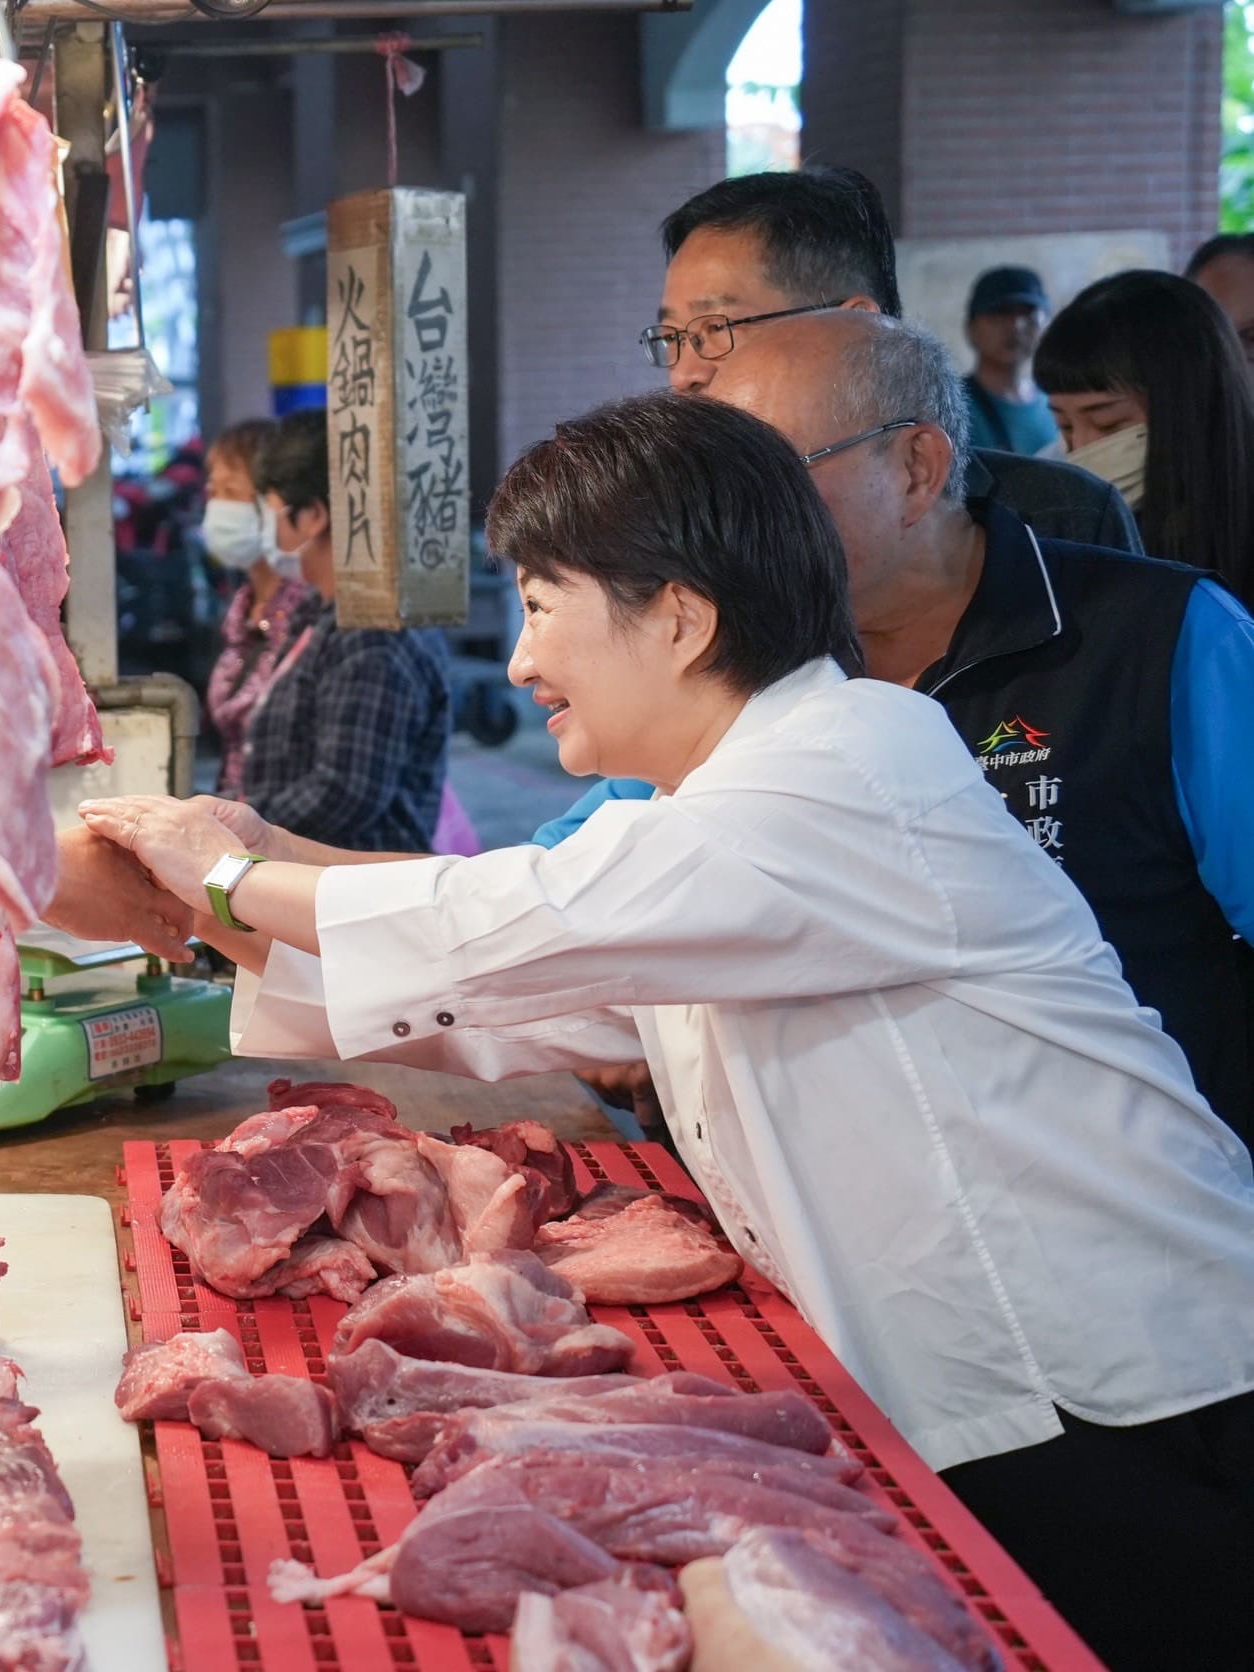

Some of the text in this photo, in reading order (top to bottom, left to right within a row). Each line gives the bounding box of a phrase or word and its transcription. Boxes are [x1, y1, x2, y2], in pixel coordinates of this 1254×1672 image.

[332, 264, 377, 567] 火鍋肉片
[406, 249, 462, 535] 台灣豬
[1025, 774, 1065, 868] 市政
